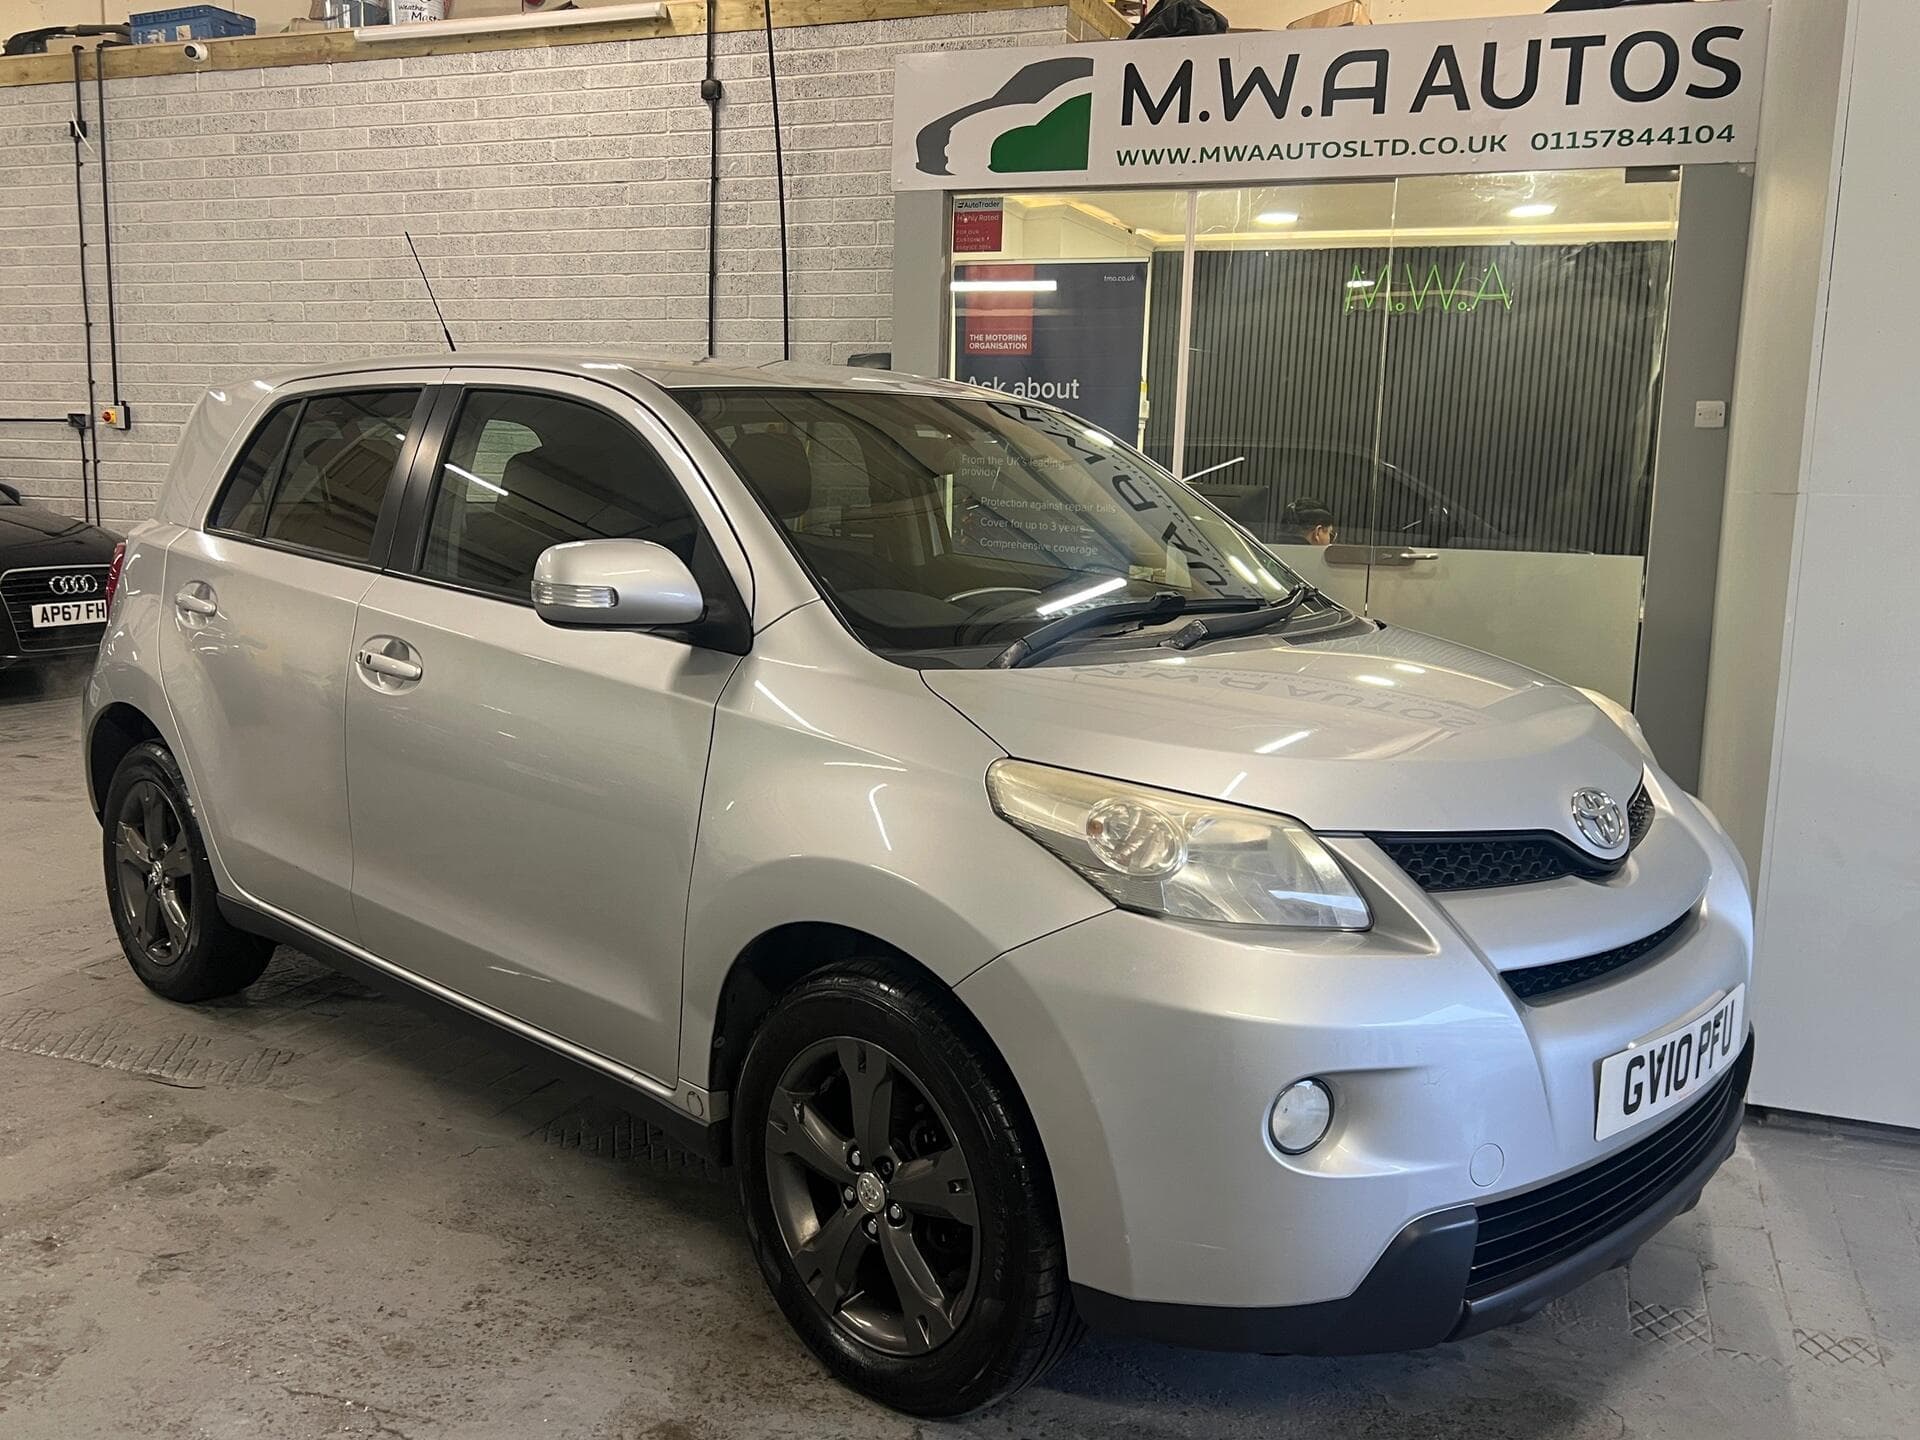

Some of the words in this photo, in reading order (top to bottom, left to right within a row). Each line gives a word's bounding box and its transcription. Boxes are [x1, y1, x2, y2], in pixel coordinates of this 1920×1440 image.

[1120, 48, 1390, 126] M.W.A
[1408, 25, 1745, 114] AUTOS
[1116, 134, 1508, 167] WWW.MWAAUTOSLTD.CO.UK
[1530, 123, 1736, 151] 01157844104
[963, 201, 1000, 209] AutoTrader
[969, 342, 1028, 350] ORGANISATION
[1013, 376, 1080, 399] about
[961, 454, 985, 465] From
[987, 456, 1004, 466] the
[961, 466, 1000, 477] provide
[980, 496, 1028, 508] Protection
[1030, 501, 1063, 511] against
[1064, 503, 1093, 513] repair
[1096, 503, 1116, 513] bills
[980, 517, 1008, 528] Cover
[1010, 519, 1023, 529] for
[1025, 522, 1038, 531] up
[1039, 521, 1049, 530] to
[1050, 521, 1057, 531] 3
[980, 537, 1051, 551] Comprehensive
[1053, 544, 1098, 557] coverage
[41, 605, 82, 624] AP67
[86, 602, 106, 619] FH
[1623, 1033, 1693, 1116] GV10
[1694, 999, 1736, 1080] PFU
